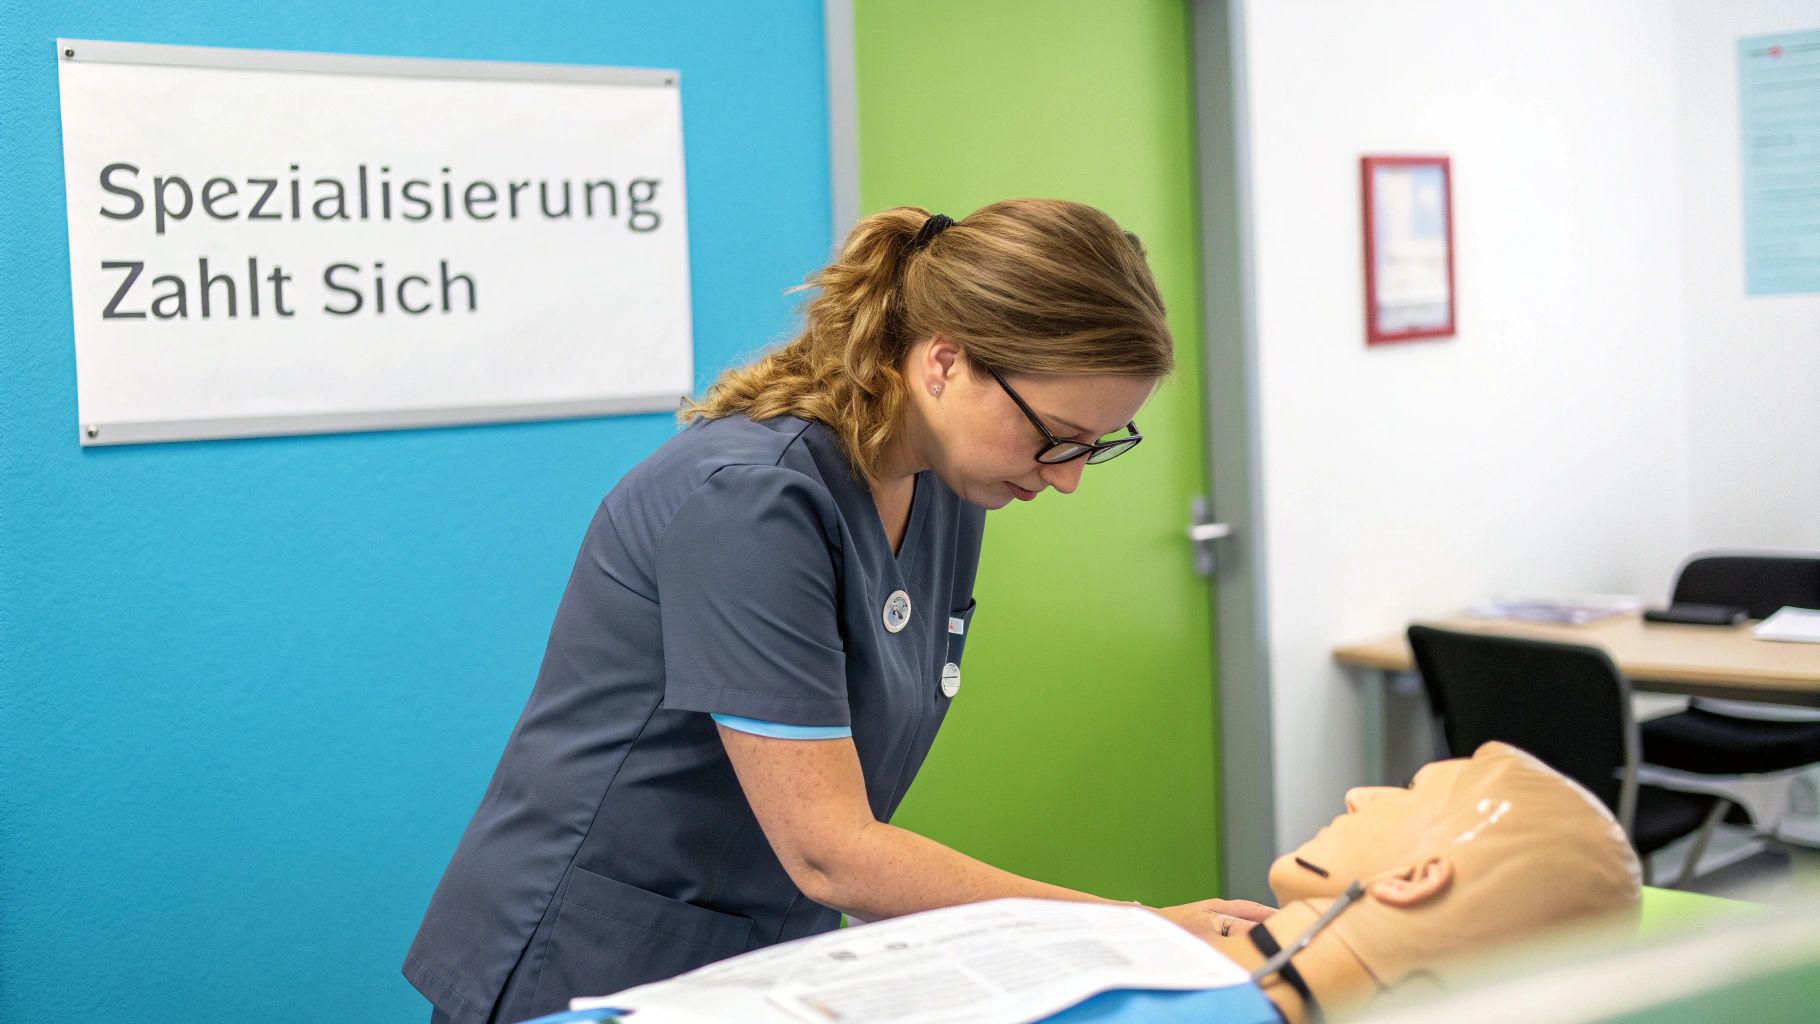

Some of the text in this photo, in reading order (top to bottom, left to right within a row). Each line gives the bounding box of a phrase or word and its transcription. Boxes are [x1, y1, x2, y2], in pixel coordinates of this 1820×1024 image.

[98, 162, 662, 235] Spezialisierung
[101, 257, 478, 320] Zahlt Sich
